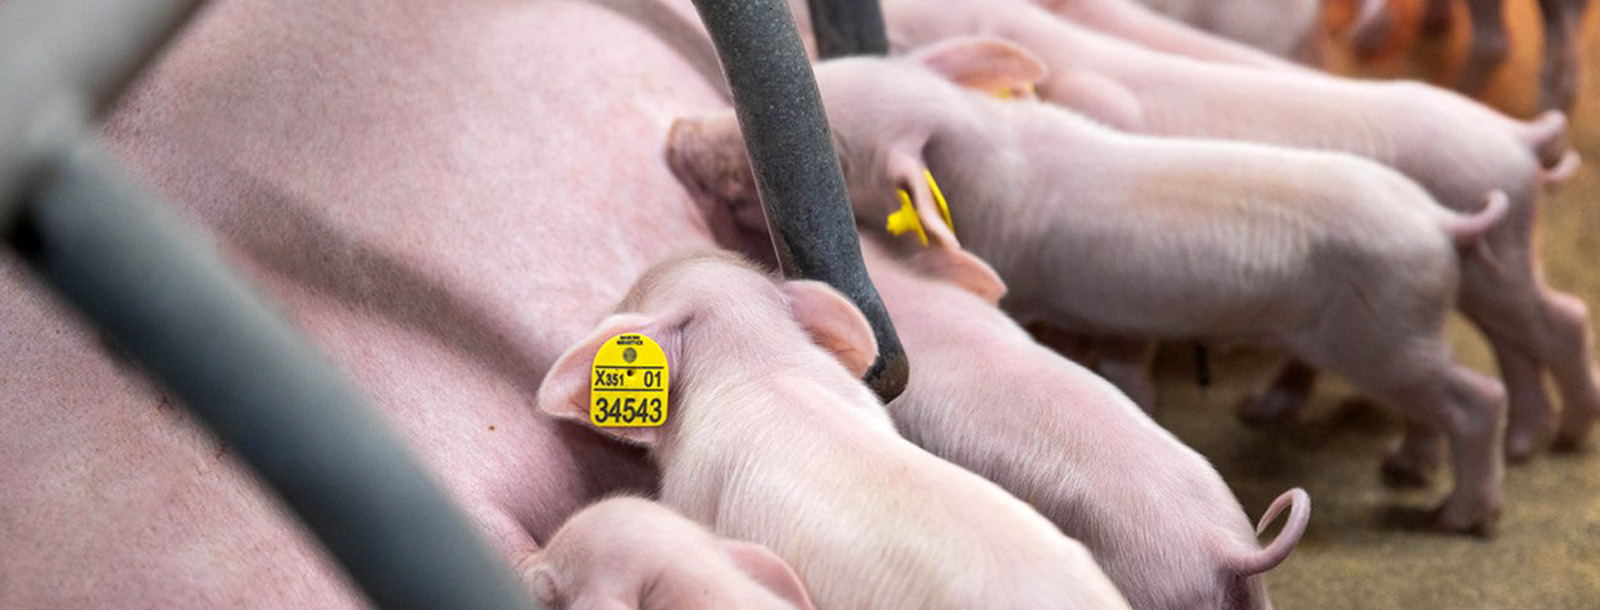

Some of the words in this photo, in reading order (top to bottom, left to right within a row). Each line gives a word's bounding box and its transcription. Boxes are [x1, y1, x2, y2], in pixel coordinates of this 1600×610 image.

[594, 370, 624, 386] X351
[644, 370, 661, 387] 01
[595, 397, 662, 423] 34543
